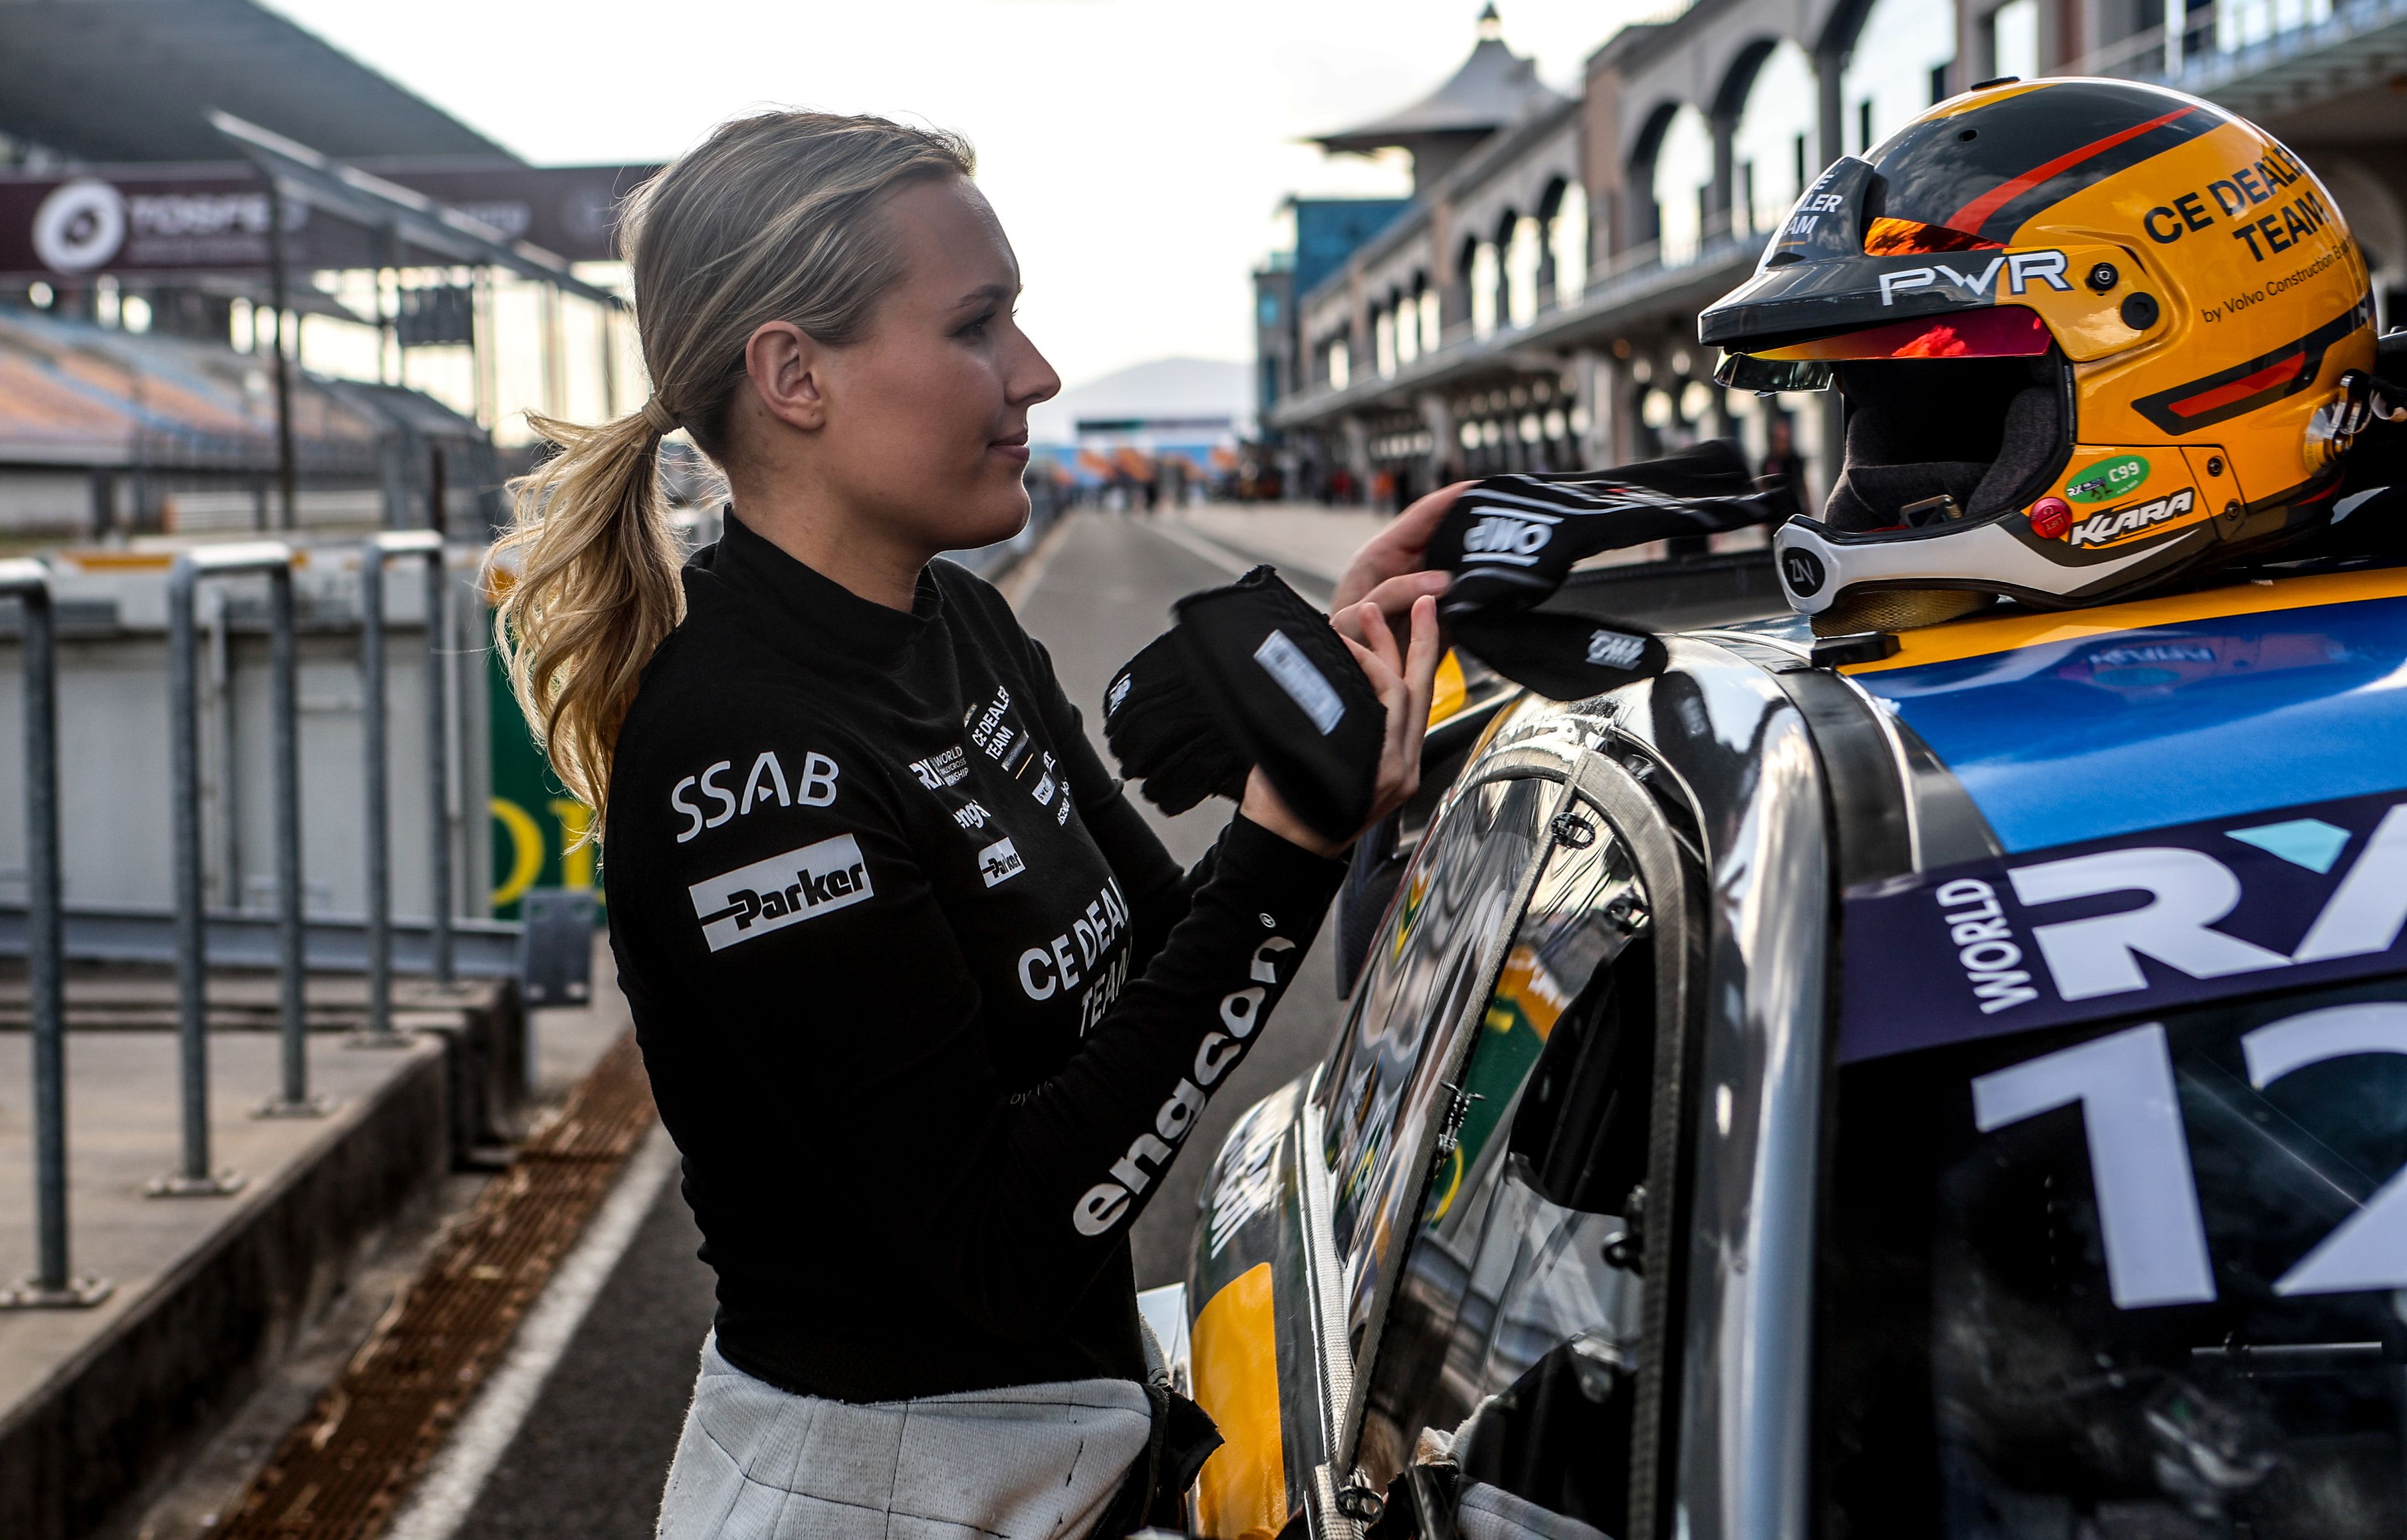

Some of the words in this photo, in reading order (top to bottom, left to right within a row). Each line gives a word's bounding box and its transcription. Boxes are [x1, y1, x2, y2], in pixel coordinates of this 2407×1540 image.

[1797, 193, 1843, 212] LER
[2144, 192, 2215, 244] CE
[2206, 147, 2304, 217] DEALE
[2232, 191, 2331, 262] TEAM
[1879, 250, 2073, 306] PWR
[2201, 308, 2222, 323] by
[2223, 289, 2264, 313] Volvo
[2266, 252, 2336, 296] Construction
[2109, 461, 2139, 483] C99
[2070, 491, 2193, 545] KLARA
[933, 745, 963, 767] WORLD
[972, 728, 987, 747] CE
[985, 725, 1015, 760] TEAM
[671, 752, 839, 843] SSAB
[987, 852, 1022, 879] Parker
[727, 862, 864, 931] Parker
[1018, 934, 1079, 1000] CE
[1936, 879, 2038, 1014] WORLD
[1073, 936, 1296, 1237] engcon
